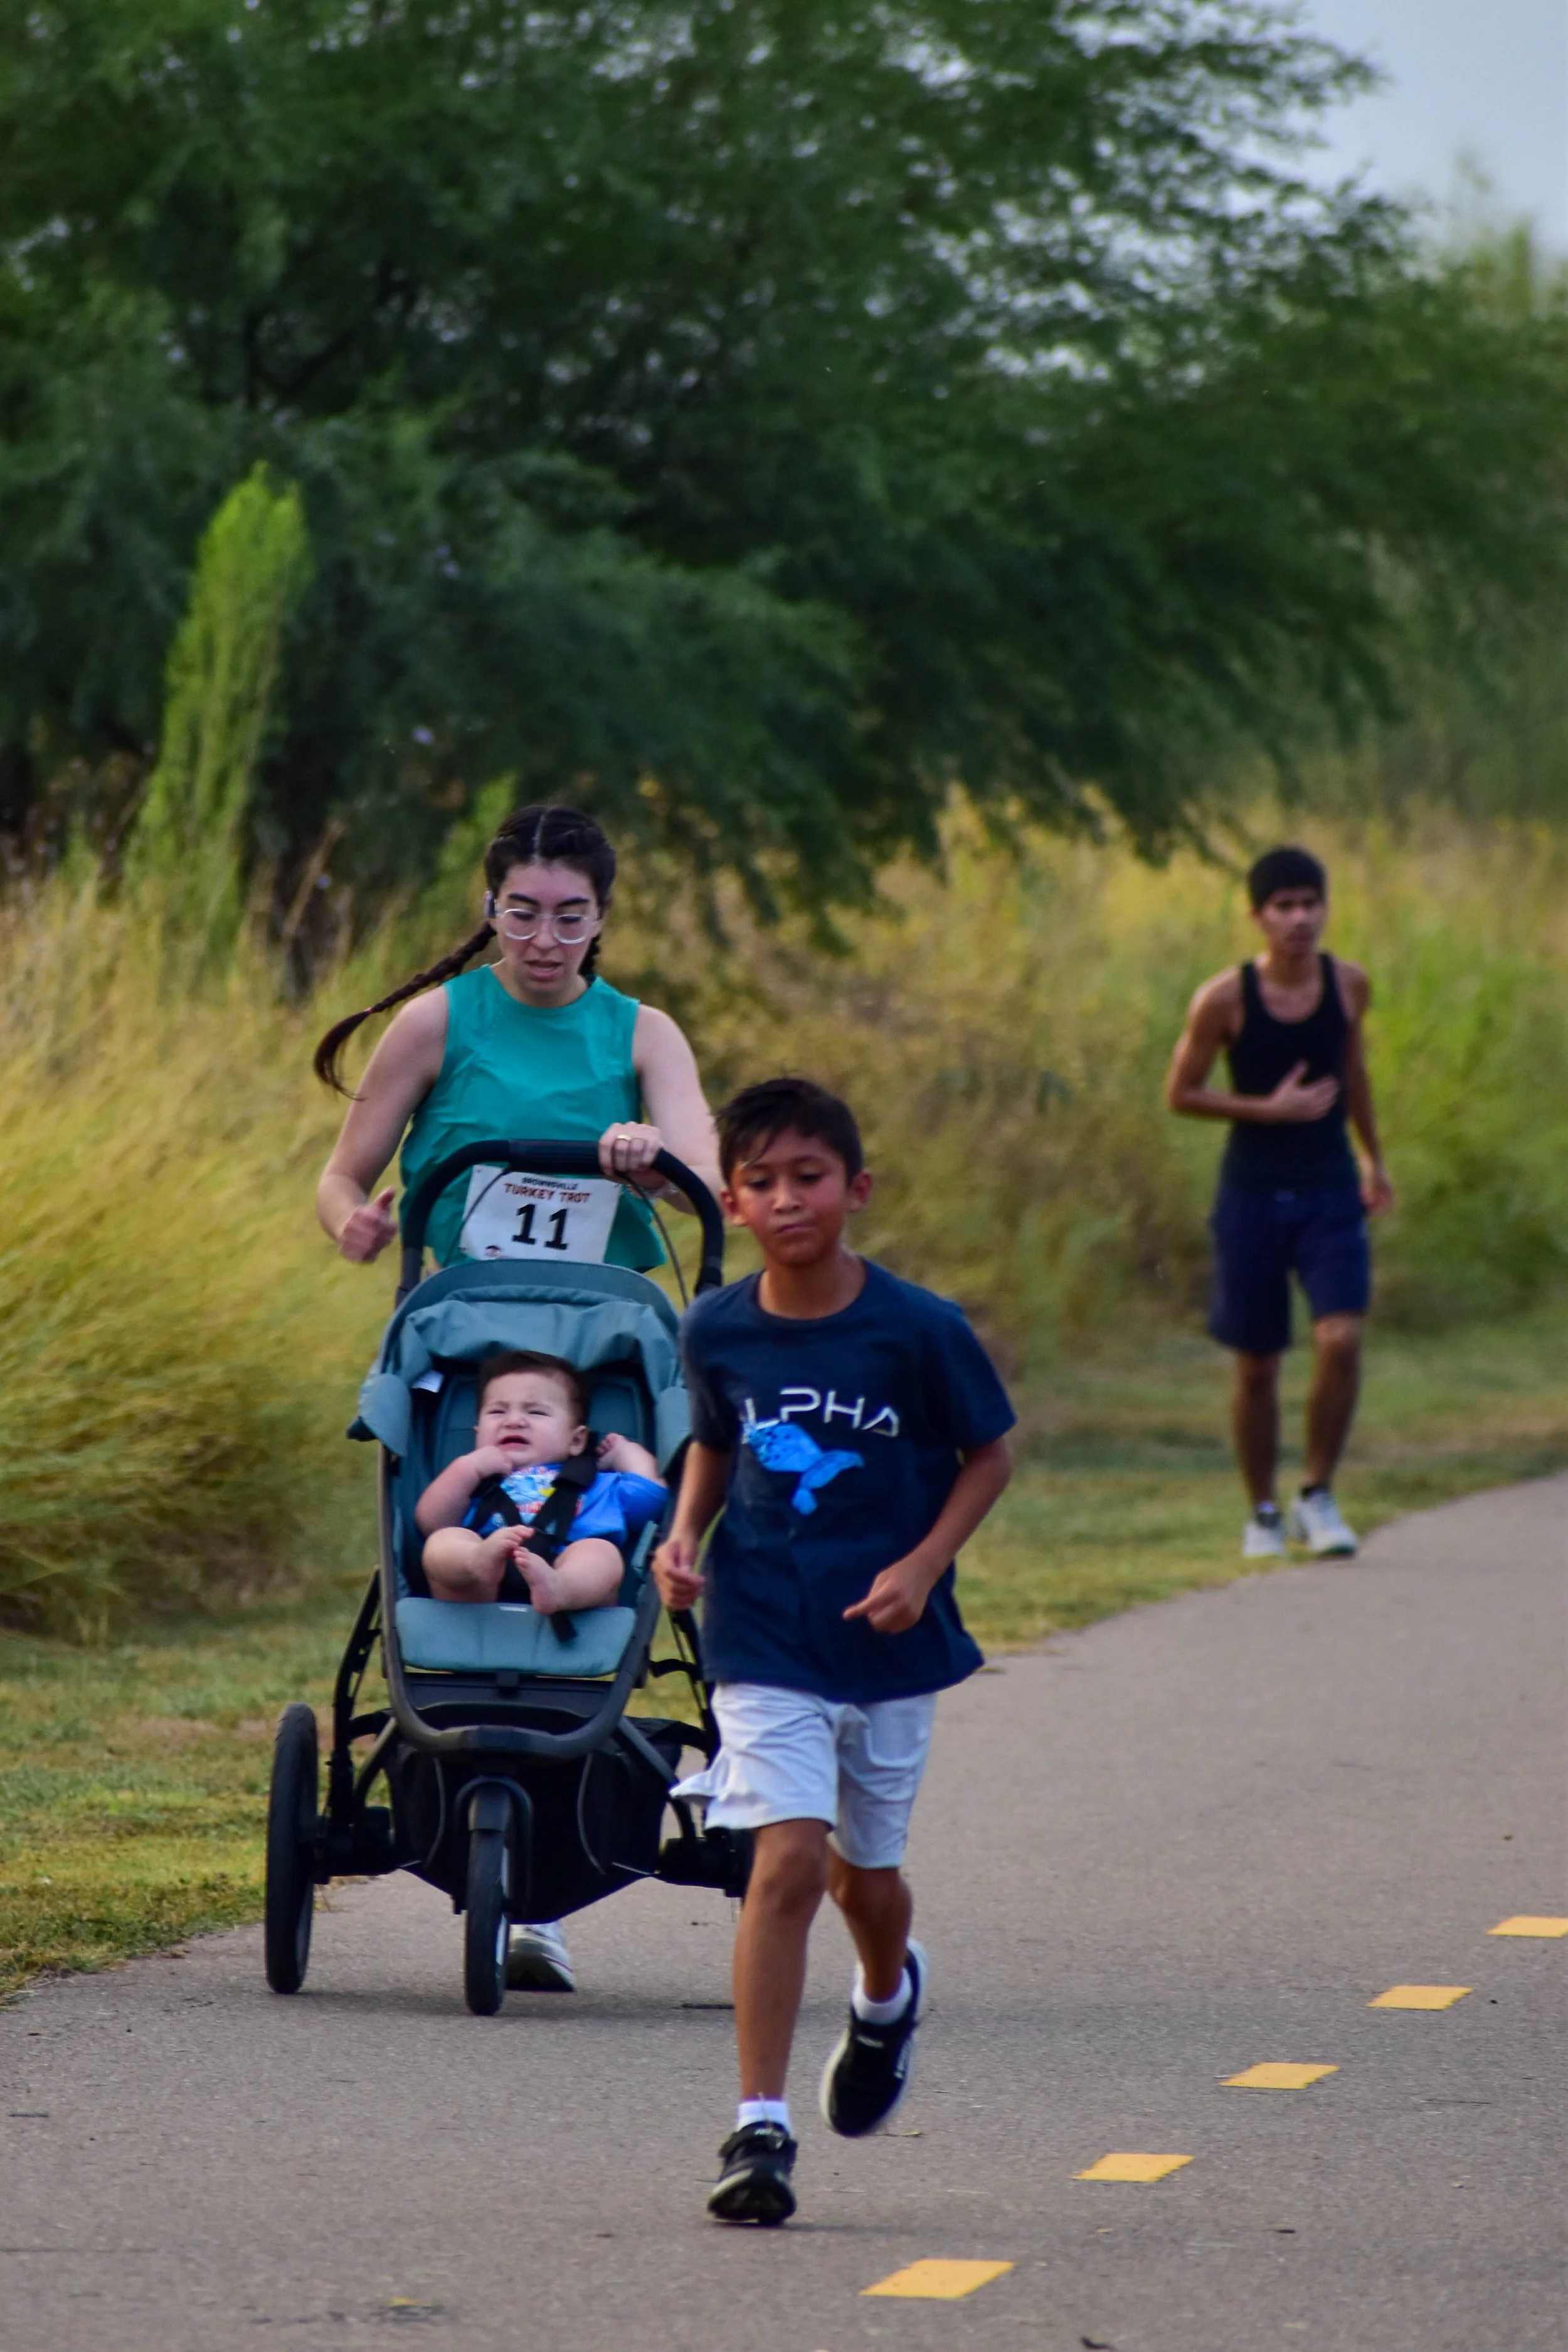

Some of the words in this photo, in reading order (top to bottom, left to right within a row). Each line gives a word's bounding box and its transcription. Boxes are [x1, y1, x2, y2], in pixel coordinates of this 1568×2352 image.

[504, 1184, 554, 1200] TURKEY
[559, 1192, 591, 1203] TROT
[512, 1204, 569, 1250] 11
[740, 1385, 900, 1444] LPHA
